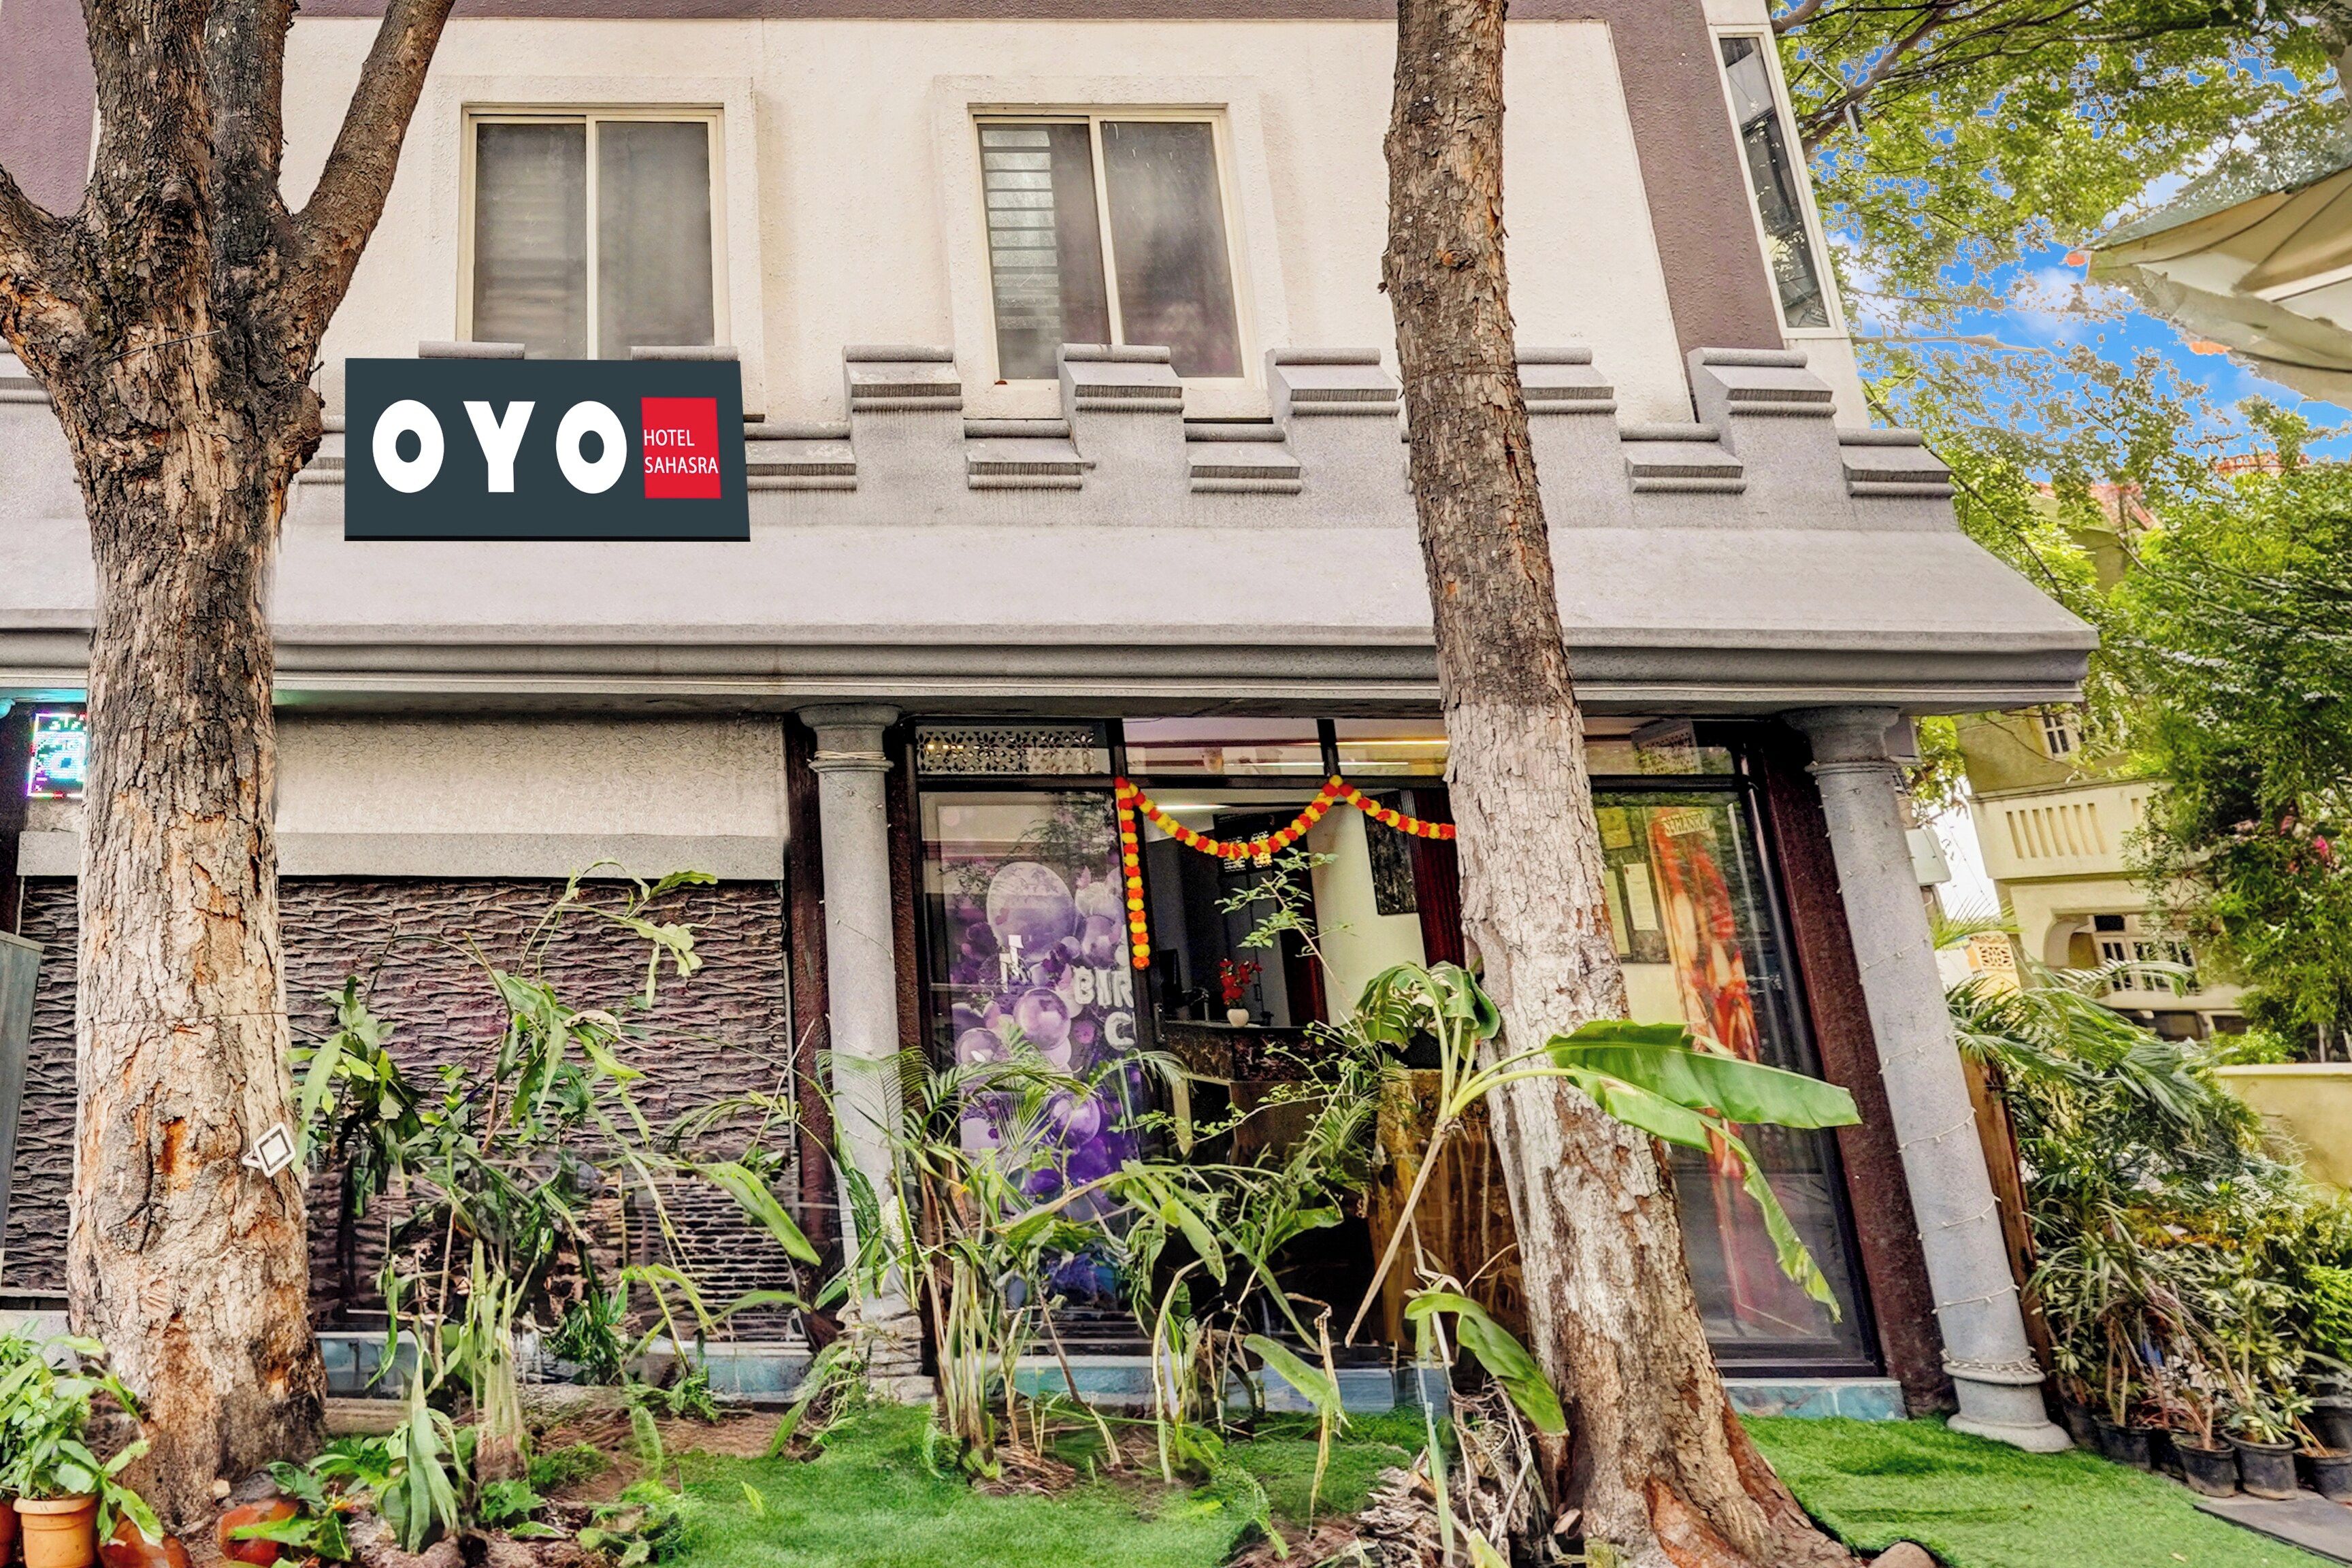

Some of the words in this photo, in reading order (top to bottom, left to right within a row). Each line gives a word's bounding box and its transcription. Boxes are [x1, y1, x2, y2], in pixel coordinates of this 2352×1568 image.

[643, 429, 695, 446] HOTEL
[372, 399, 627, 494] OYO
[644, 457, 719, 474] SAHASRA
